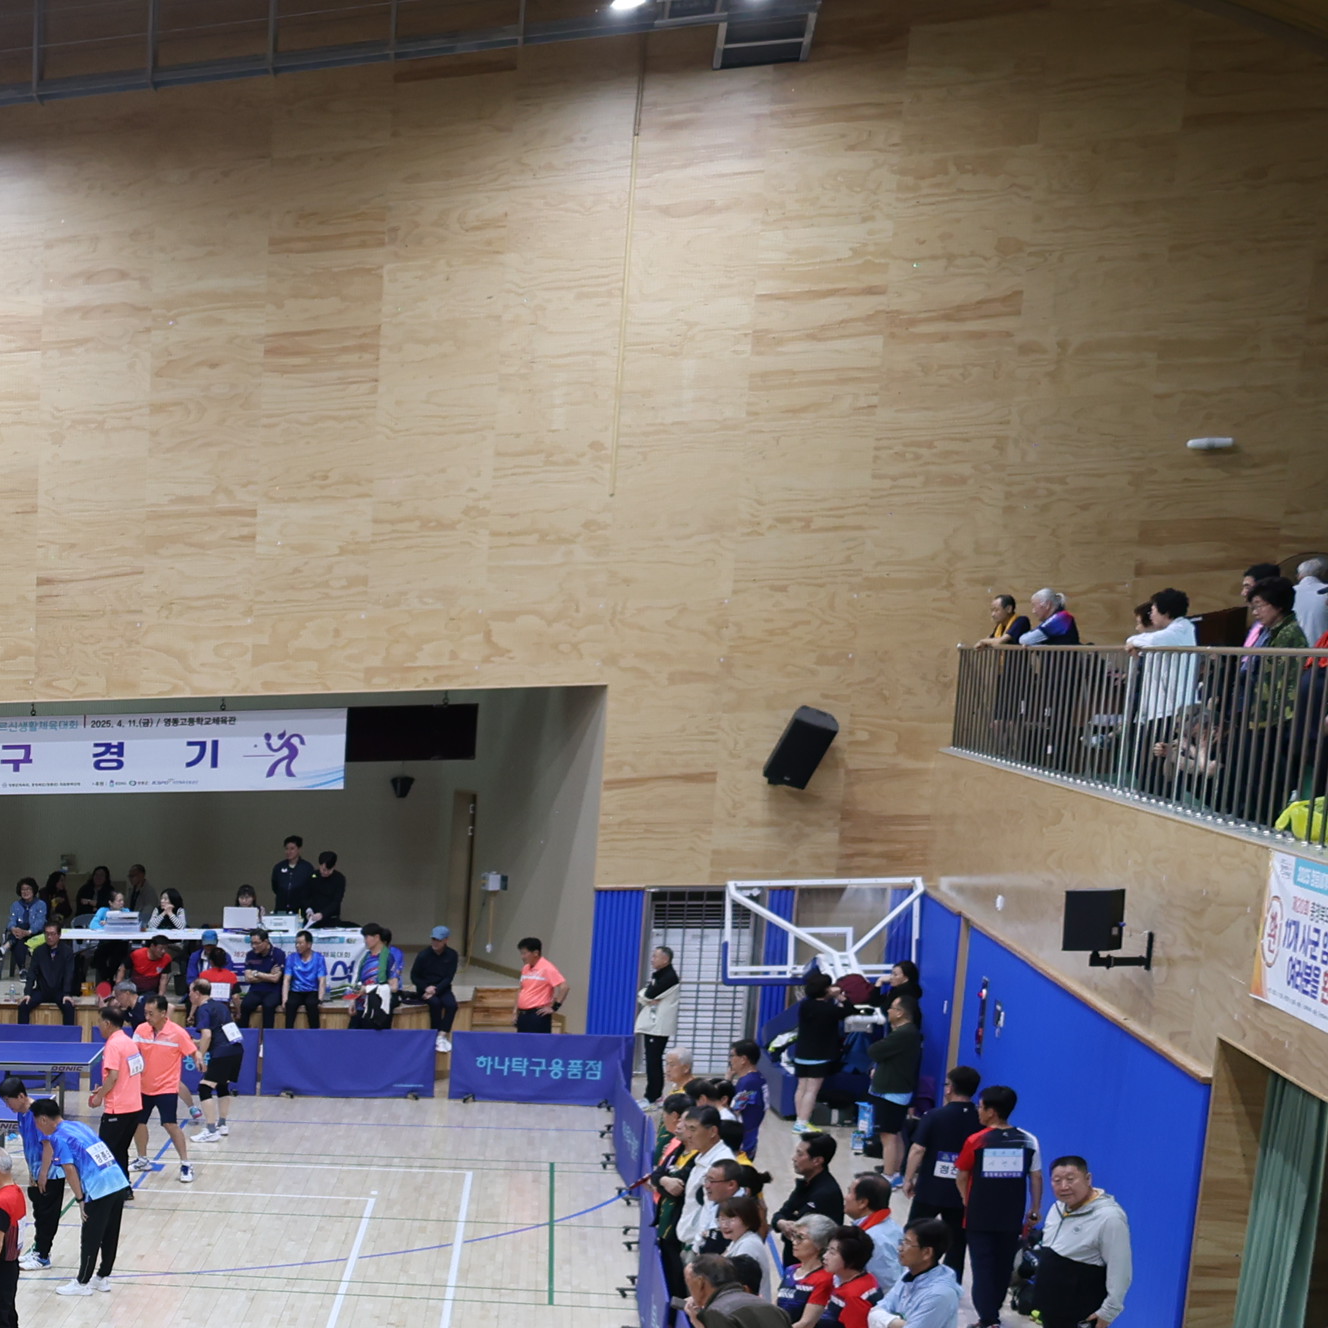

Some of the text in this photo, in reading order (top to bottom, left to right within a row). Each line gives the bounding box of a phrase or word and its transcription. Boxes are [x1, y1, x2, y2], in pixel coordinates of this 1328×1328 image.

[0, 744, 33, 773] 구
[92, 741, 125, 771] 경
[185, 739, 219, 769] 기
[476, 1055, 602, 1081] 하나탁구용품점
